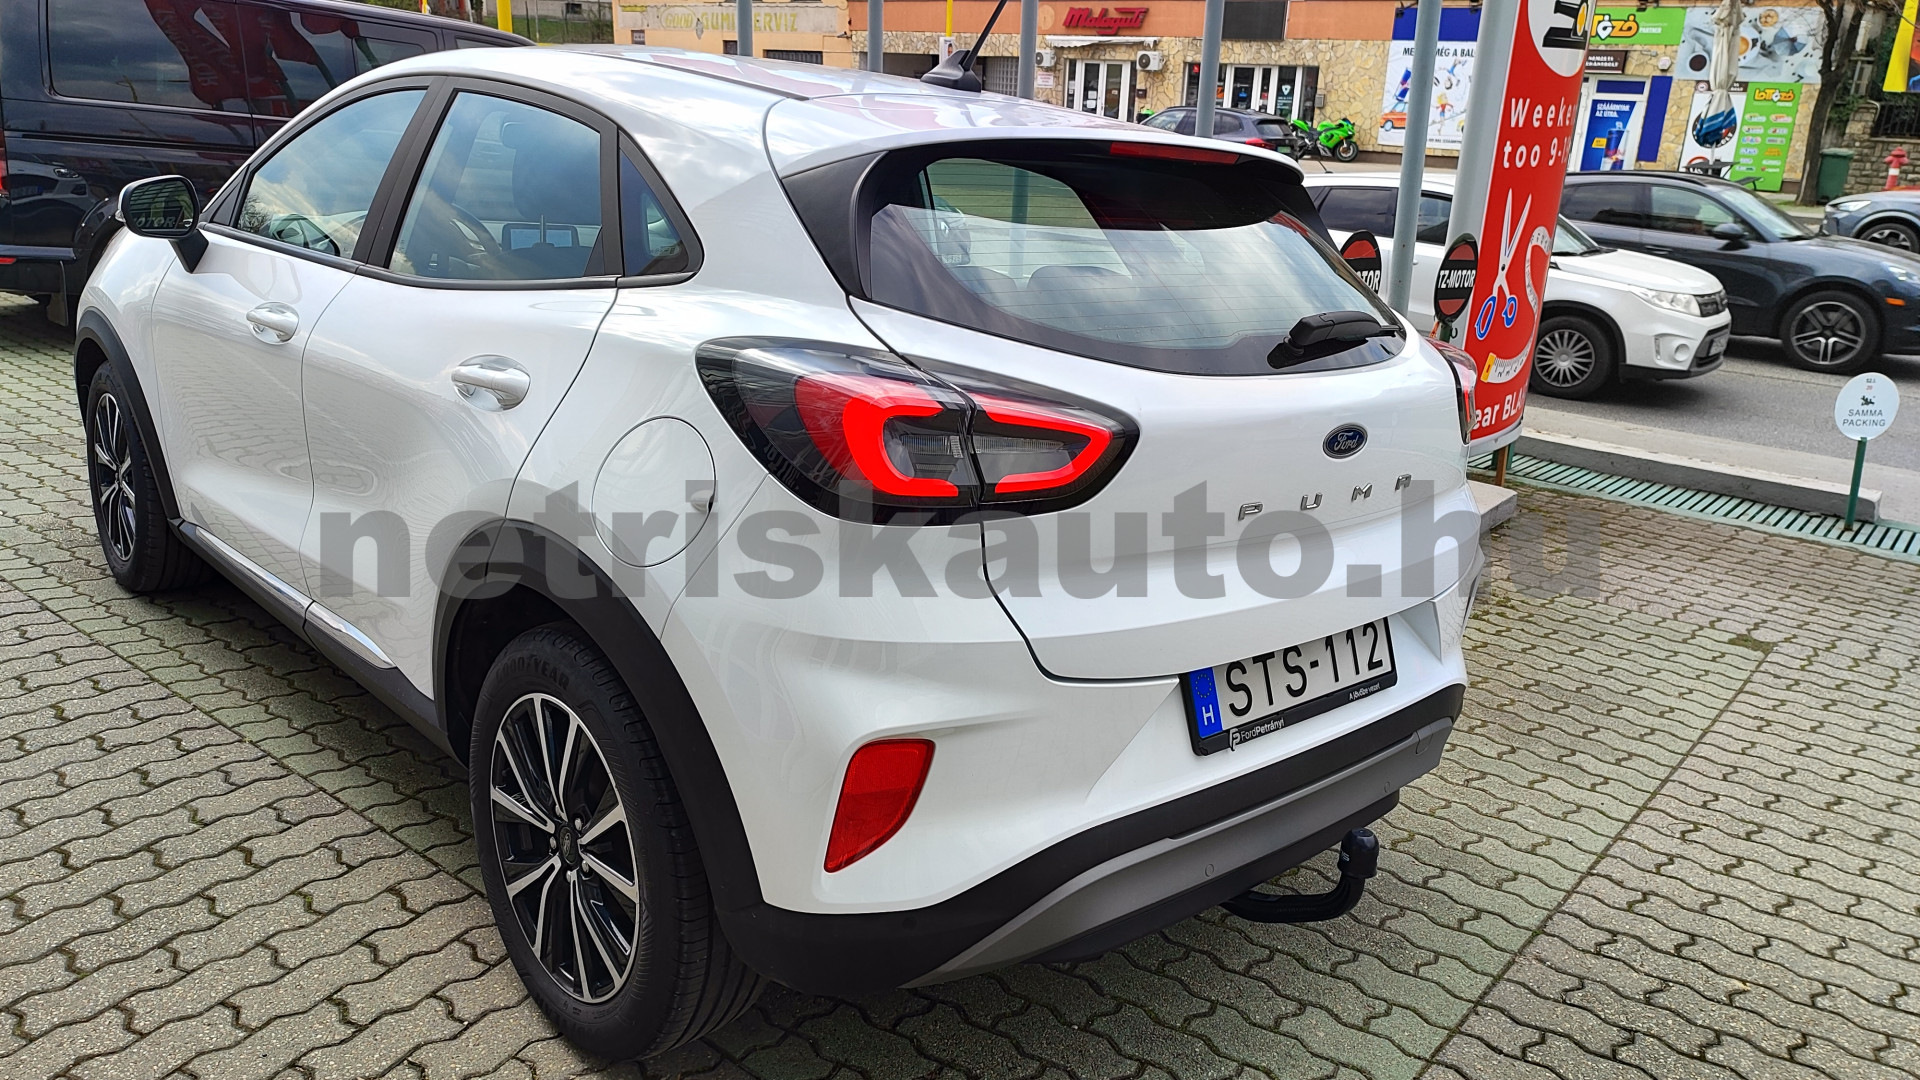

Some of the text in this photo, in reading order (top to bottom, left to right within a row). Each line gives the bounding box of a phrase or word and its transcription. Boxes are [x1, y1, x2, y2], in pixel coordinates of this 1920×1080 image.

[754, 13, 798, 32] ERVIZ
[1063, 7, 1149, 35] Malaguti
[1503, 140, 1541, 169] too
[1438, 269, 1476, 289] TZ-MOTOR
[1847, 408, 1883, 418] SAMMA
[1842, 419, 1886, 427] PACKING
[1334, 432, 1358, 450] Ford
[1202, 623, 1384, 725] H STS-112
